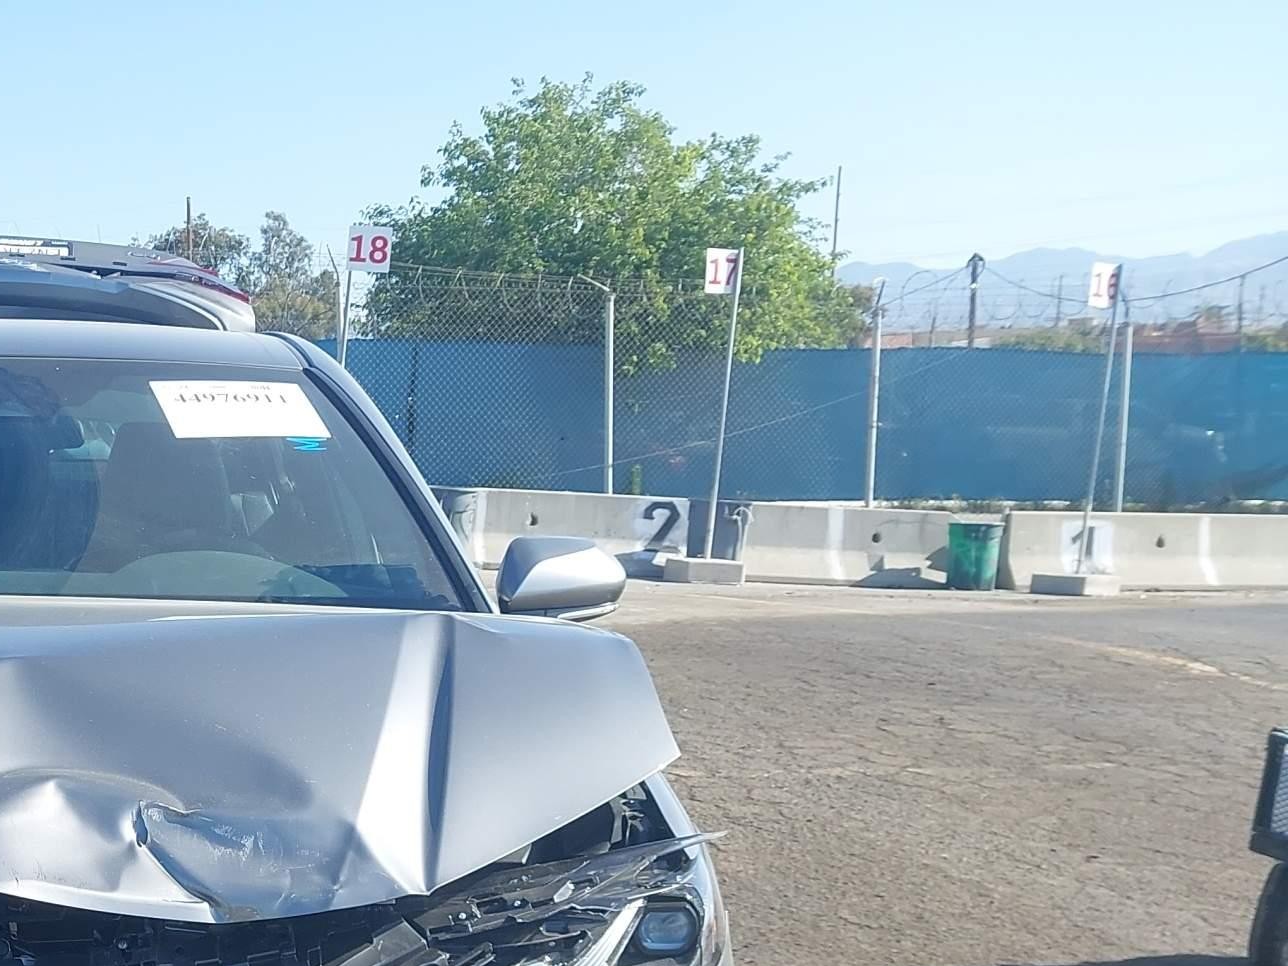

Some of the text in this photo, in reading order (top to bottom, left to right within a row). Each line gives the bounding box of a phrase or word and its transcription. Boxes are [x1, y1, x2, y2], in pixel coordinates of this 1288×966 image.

[349, 235, 389, 264] 18
[709, 257, 738, 286] 17
[643, 502, 681, 553] 2
